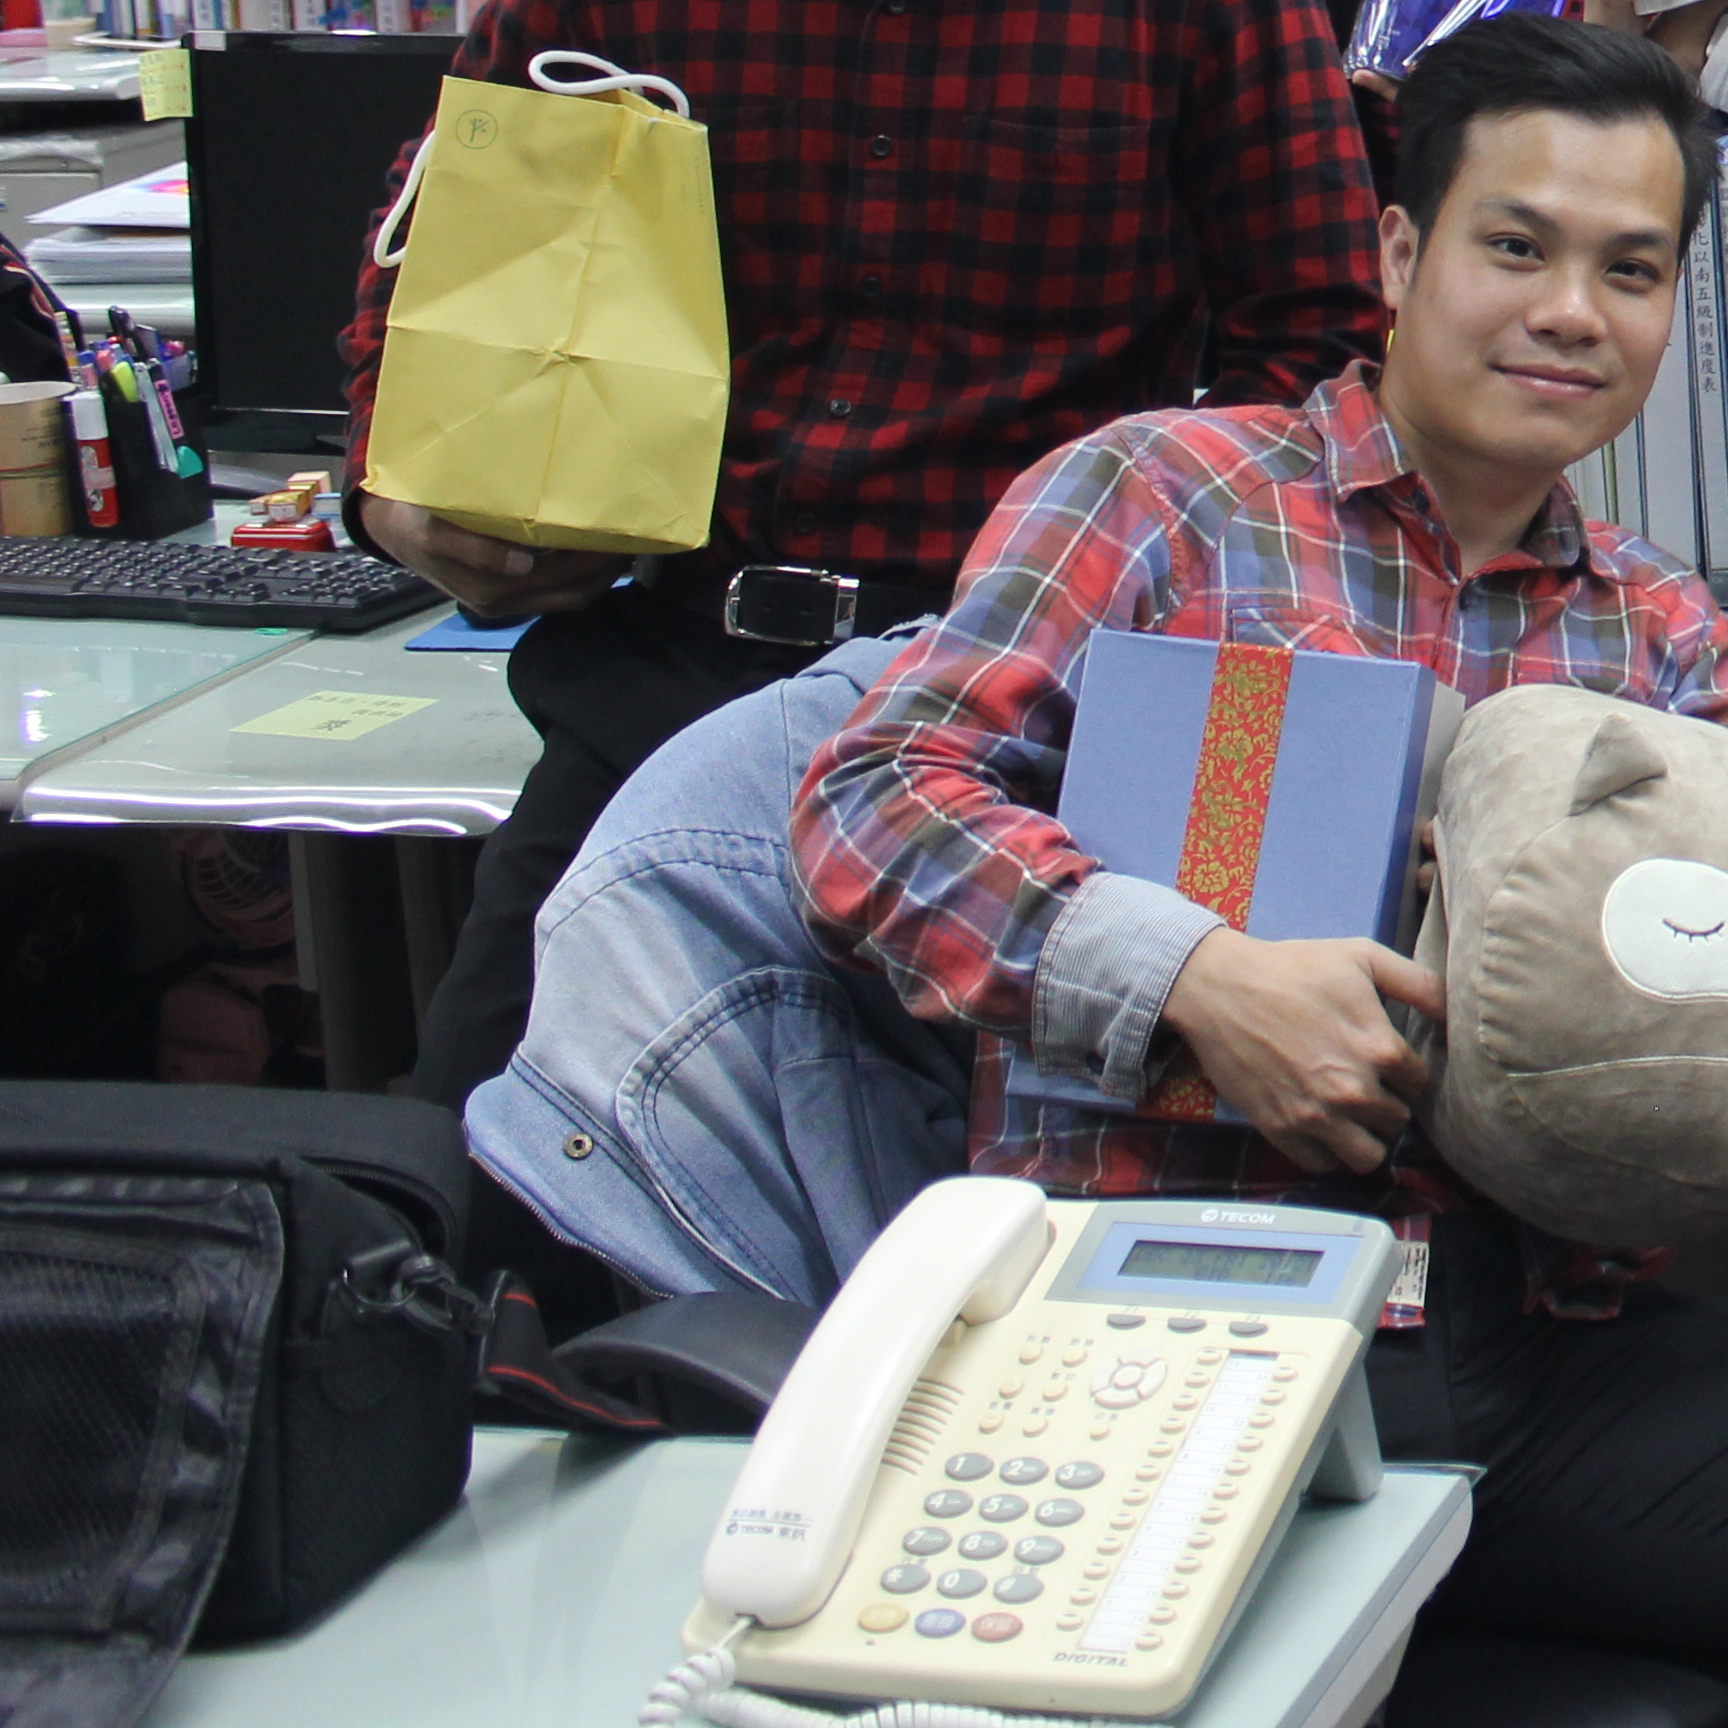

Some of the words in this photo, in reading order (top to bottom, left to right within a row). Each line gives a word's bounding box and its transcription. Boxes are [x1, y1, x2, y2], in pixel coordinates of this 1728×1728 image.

[1219, 1211, 1277, 1225] TECOM
[953, 1456, 966, 1472] 1
[1005, 1460, 1023, 1476] 2
[1058, 1464, 1076, 1480] 3
[928, 1493, 946, 1508] 4
[983, 1497, 1001, 1513] 5
[1039, 1501, 1055, 1518] 6
[907, 1530, 924, 1545] 7
[963, 1534, 981, 1550] 8
[1020, 1538, 1036, 1554] 9
[943, 1572, 961, 1588] 0
[1051, 1651, 1128, 1667] DIGITAL
